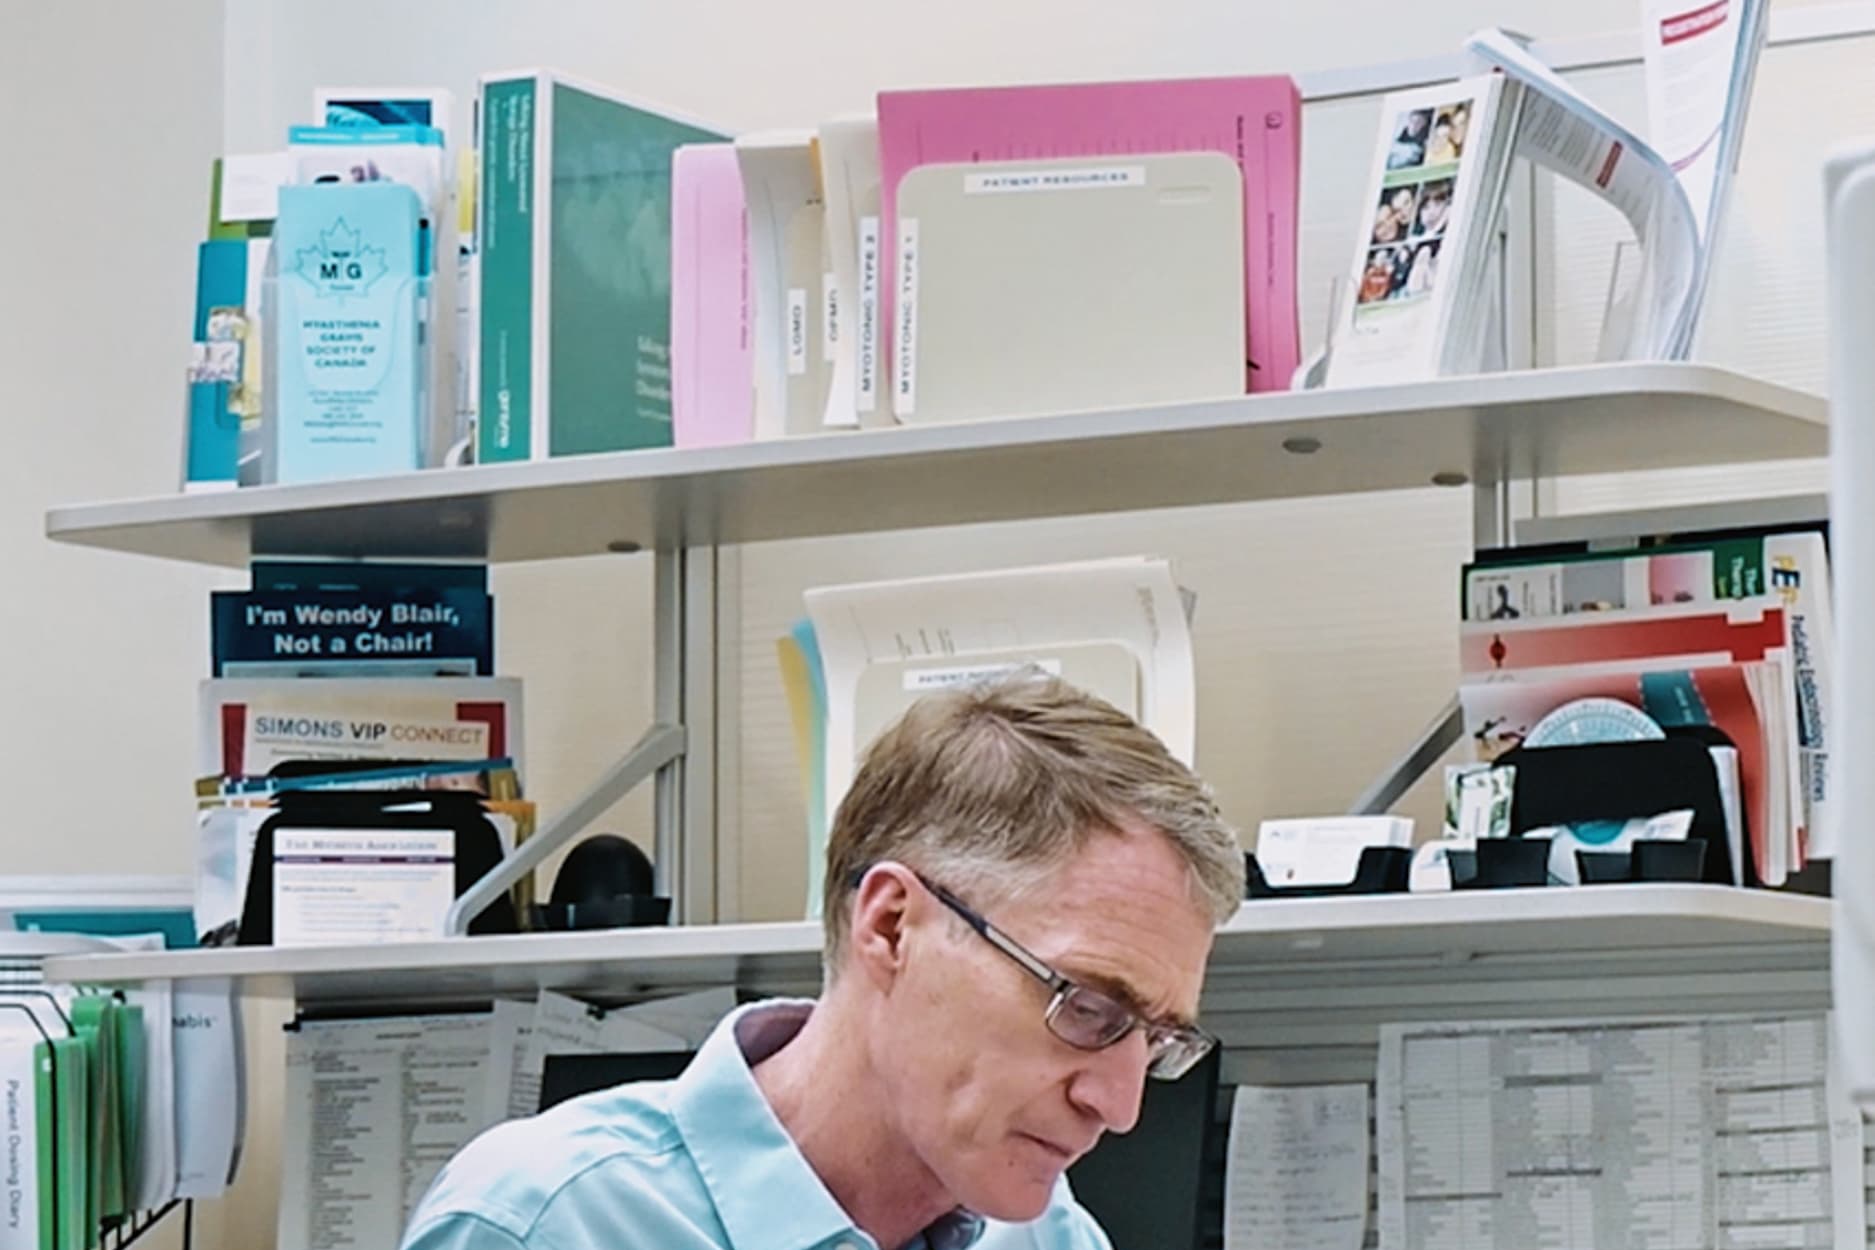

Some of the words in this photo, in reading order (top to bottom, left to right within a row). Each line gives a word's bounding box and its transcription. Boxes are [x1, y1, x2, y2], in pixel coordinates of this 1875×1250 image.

[983, 176, 1038, 187] PATIENT
[864, 251, 875, 292] TYPE
[903, 252, 913, 293] TYPE
[306, 345, 357, 354] SOCIETY
[861, 300, 874, 392] MYOTONIC
[901, 301, 912, 394] MYOTONIC
[314, 359, 367, 368] CANADA
[246, 605, 287, 626] I'm
[294, 603, 383, 629] Wendy
[391, 603, 460, 627] Blair,
[274, 633, 321, 654] Not
[330, 637, 347, 653] a
[355, 631, 433, 652] Chair!
[255, 716, 343, 738] SIMONS
[350, 722, 387, 741] VIP
[390, 725, 483, 745] CONNECT
